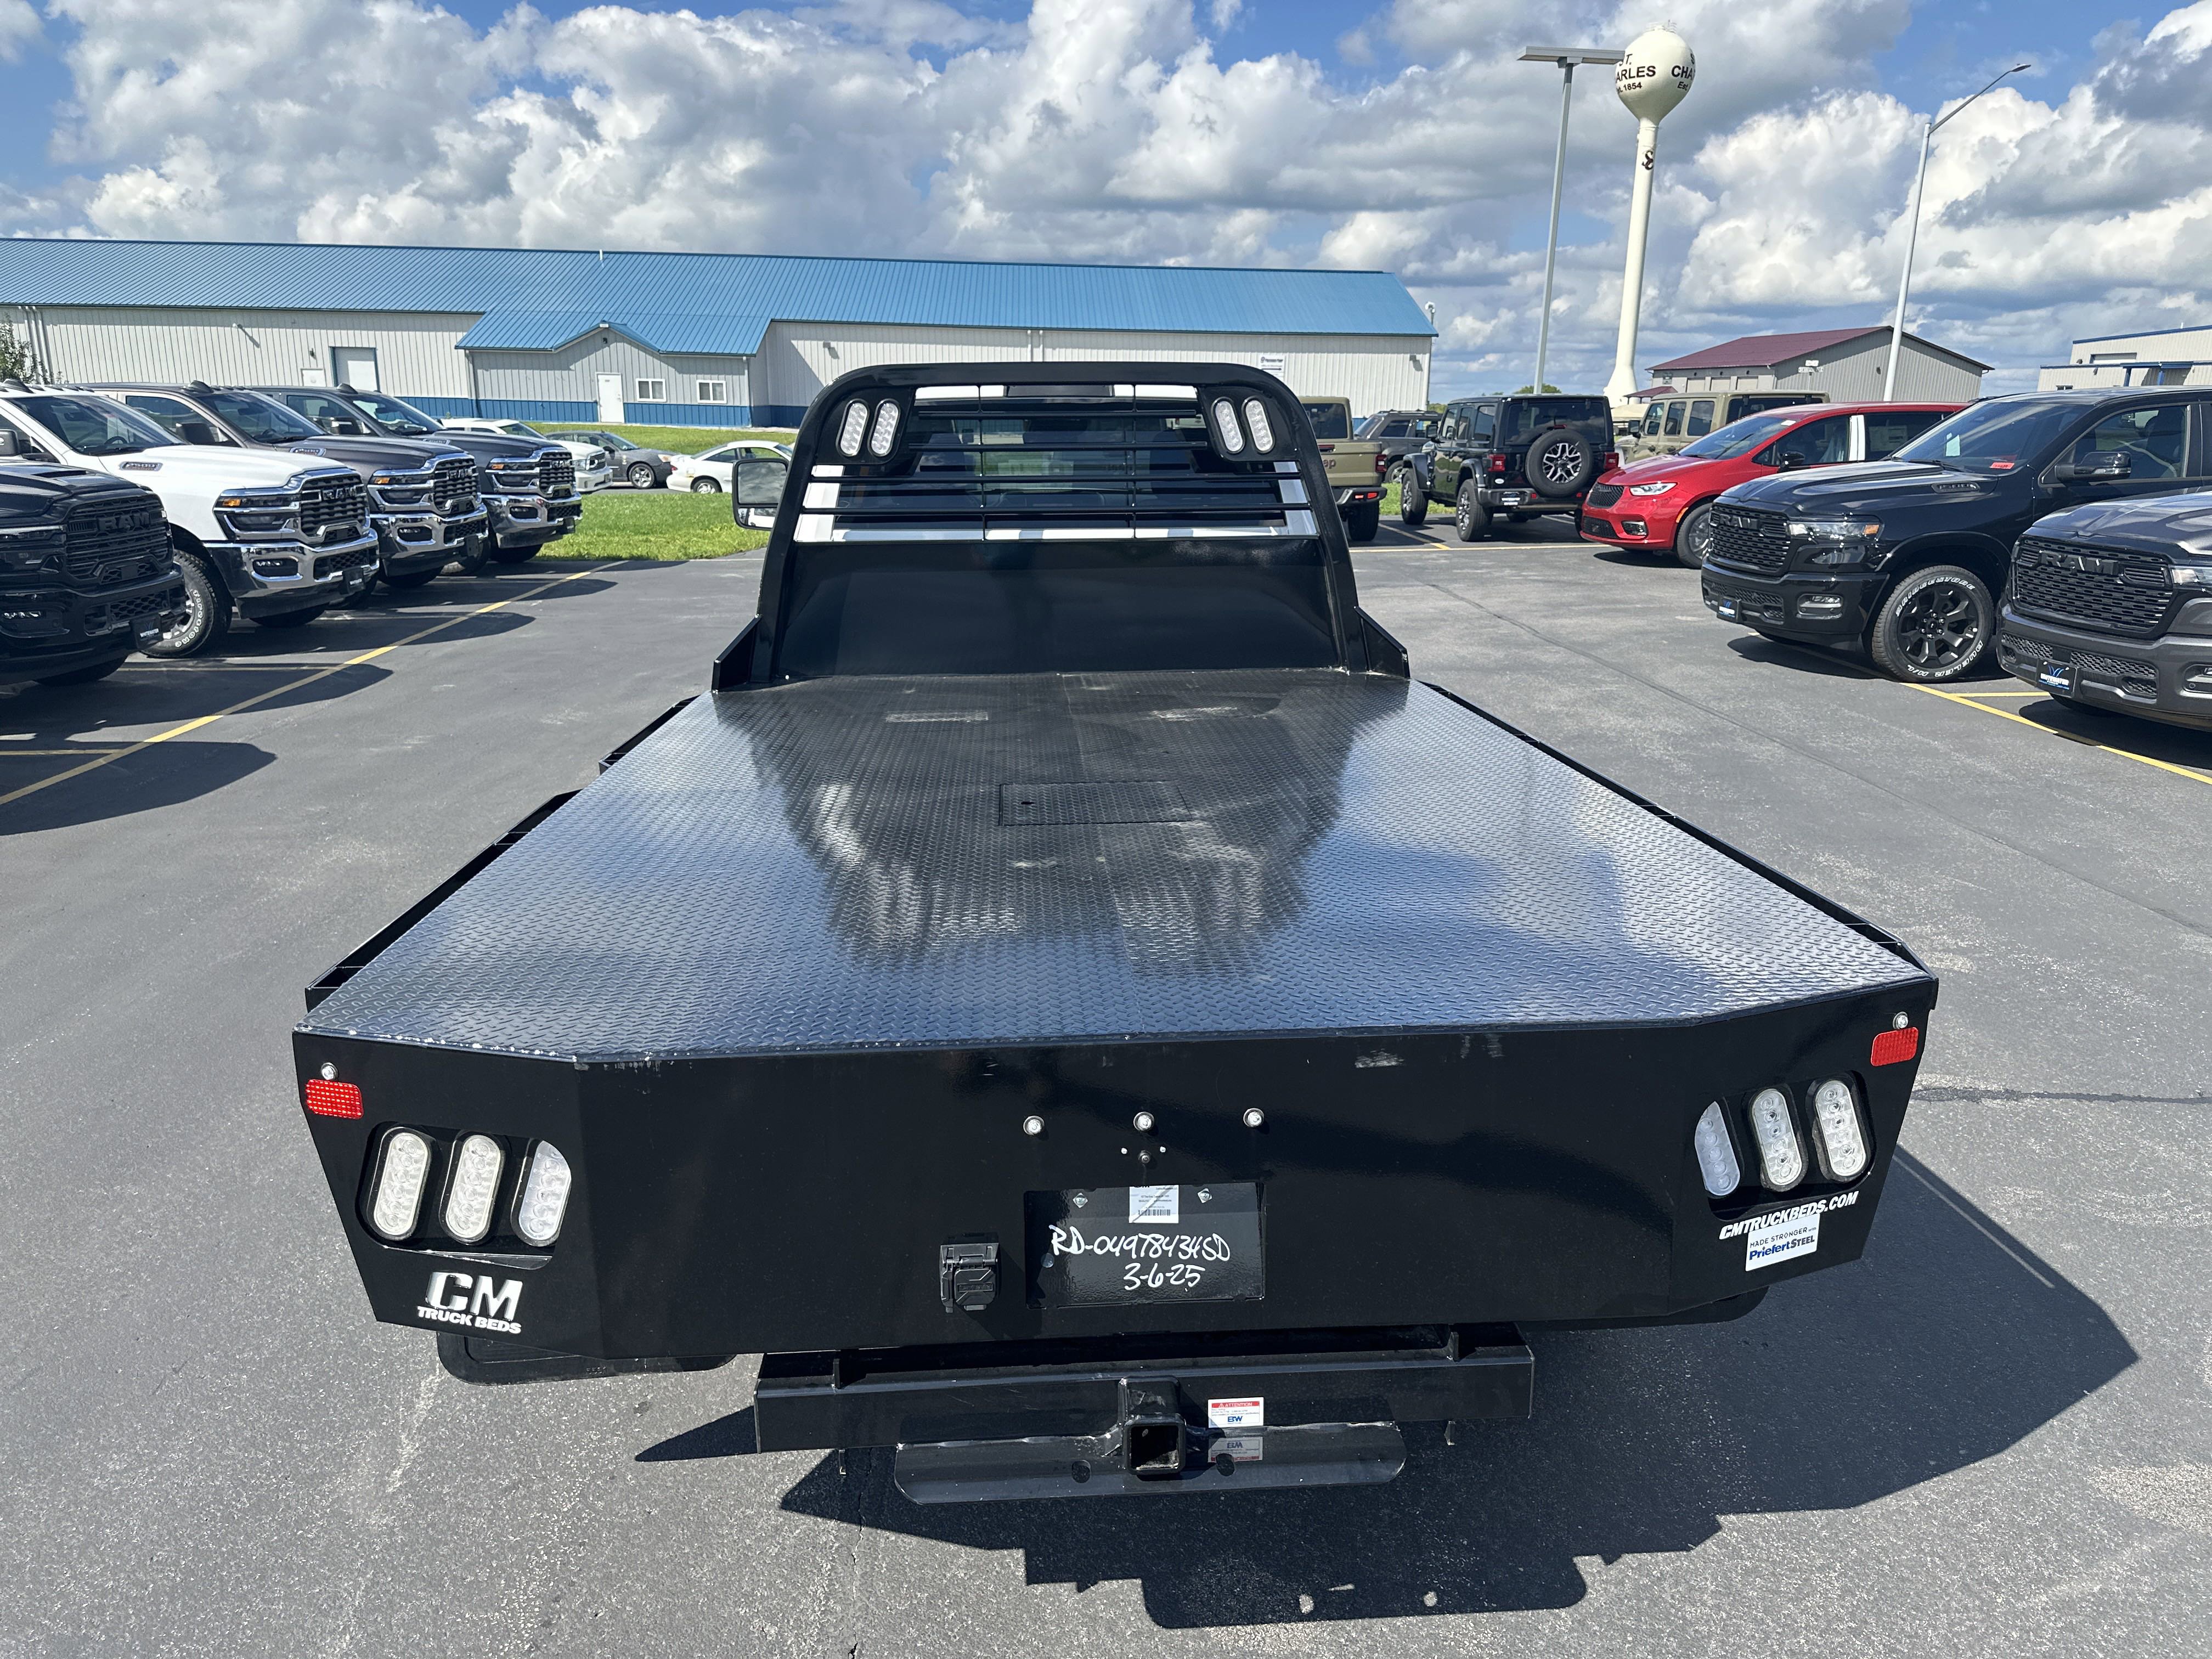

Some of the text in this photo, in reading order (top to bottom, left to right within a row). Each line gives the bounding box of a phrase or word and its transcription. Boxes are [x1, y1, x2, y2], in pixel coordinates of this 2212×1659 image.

[1616, 65, 1656, 83] ARLES
[1671, 65, 1695, 81] CHA
[1623, 82, 1643, 91] 1854
[1323, 459, 1336, 469] ep
[323, 486, 357, 500] RAM
[99, 511, 149, 531] RAM
[1719, 514, 1759, 529] RAM
[2040, 550, 2120, 575] RAM
[1719, 1190, 1859, 1240] CMTRUCKBEDS.COM
[1750, 1227, 1807, 1249] MADE STRONGER
[1124, 1262, 1206, 1290] 3-6-25
[425, 1271, 523, 1322] CM
[417, 1306, 522, 1335] TRUCK BEDS
